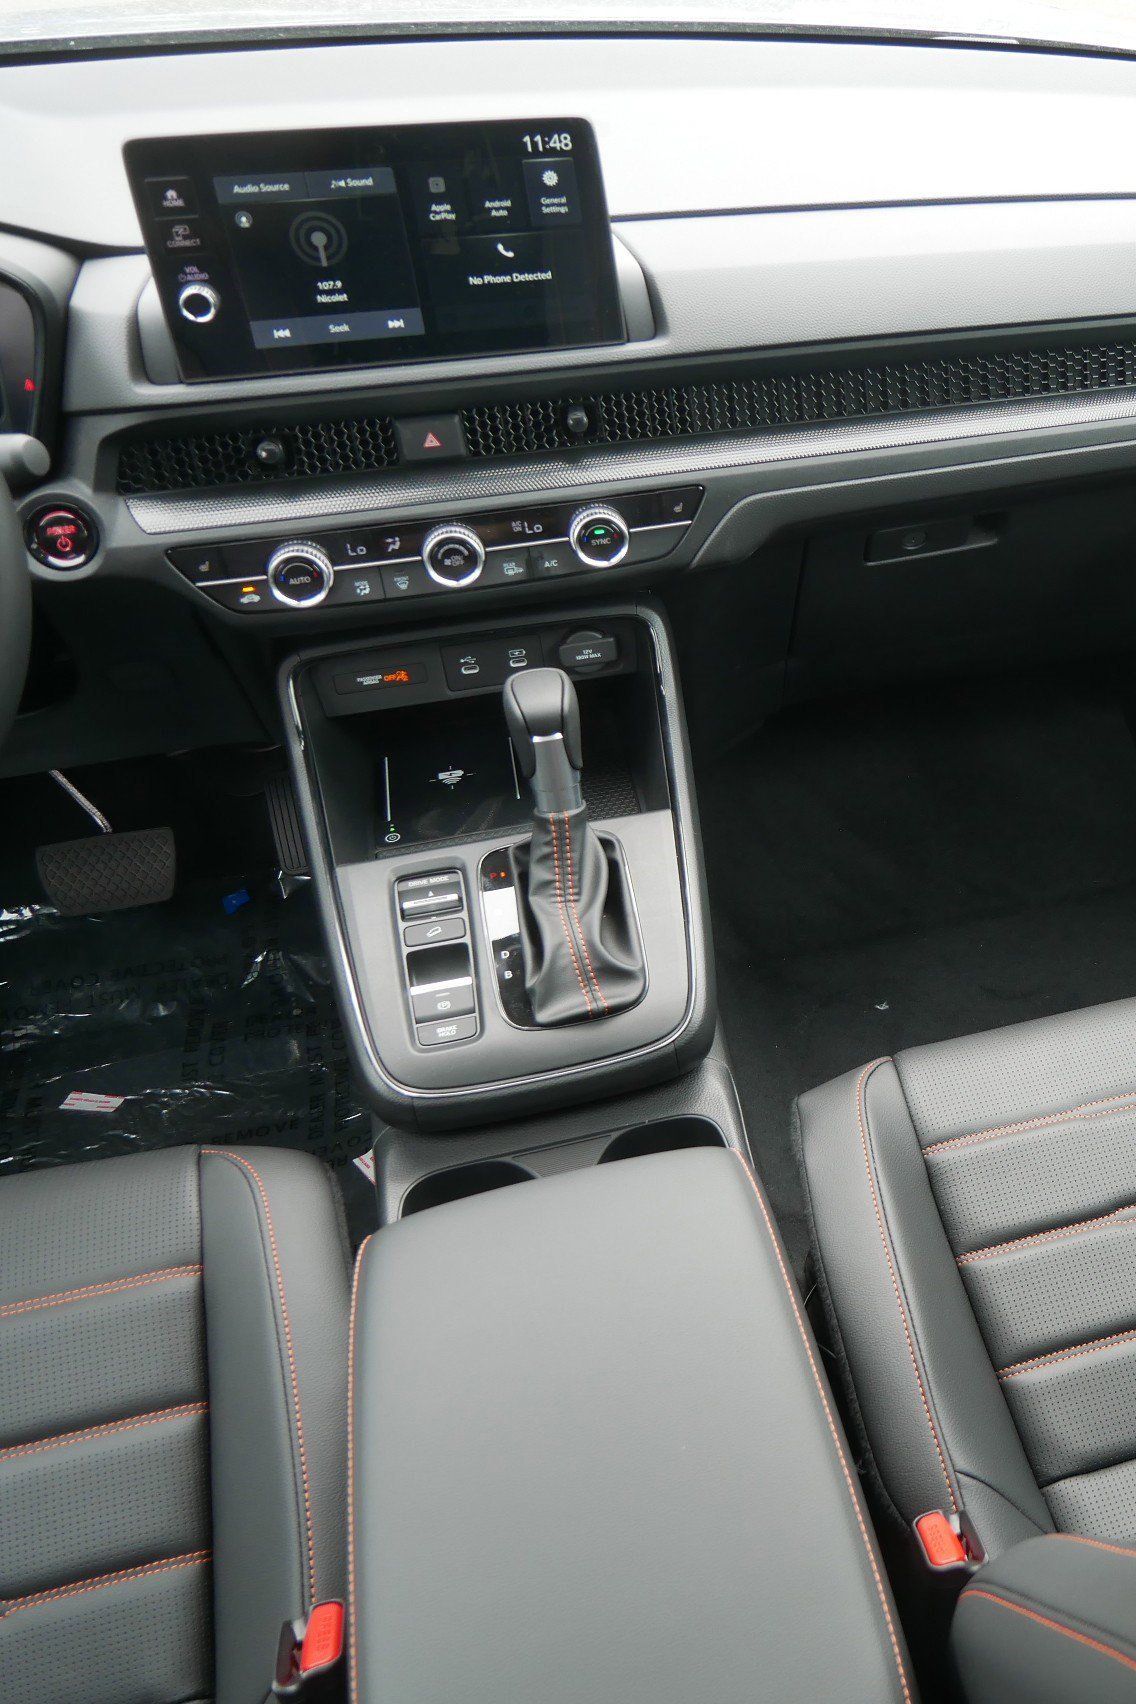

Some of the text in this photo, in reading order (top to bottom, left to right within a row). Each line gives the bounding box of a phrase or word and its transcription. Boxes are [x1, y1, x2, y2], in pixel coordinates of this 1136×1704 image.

[522, 133, 573, 153] 11:48
[346, 177, 373, 188] Sound
[233, 182, 290, 194] Audio Source
[484, 200, 511, 209] Android
[540, 196, 566, 206] General
[430, 203, 451, 214] Apple
[491, 209, 508, 218] Auto
[542, 205, 568, 215] Settings
[469, 270, 552, 286] No Phone Detected
[316, 280, 342, 291] 107.9
[328, 322, 350, 334] Seek
[524, 522, 542, 534] Lo
[591, 536, 612, 546] SYNC
[346, 544, 366, 556] Lo
[544, 560, 558, 568] A/C
[289, 575, 312, 584] AUTO
[408, 874, 450, 888] DRIVE MODE
[490, 872, 496, 880] P
[500, 950, 510, 959] D
[504, 970, 512, 979] B
